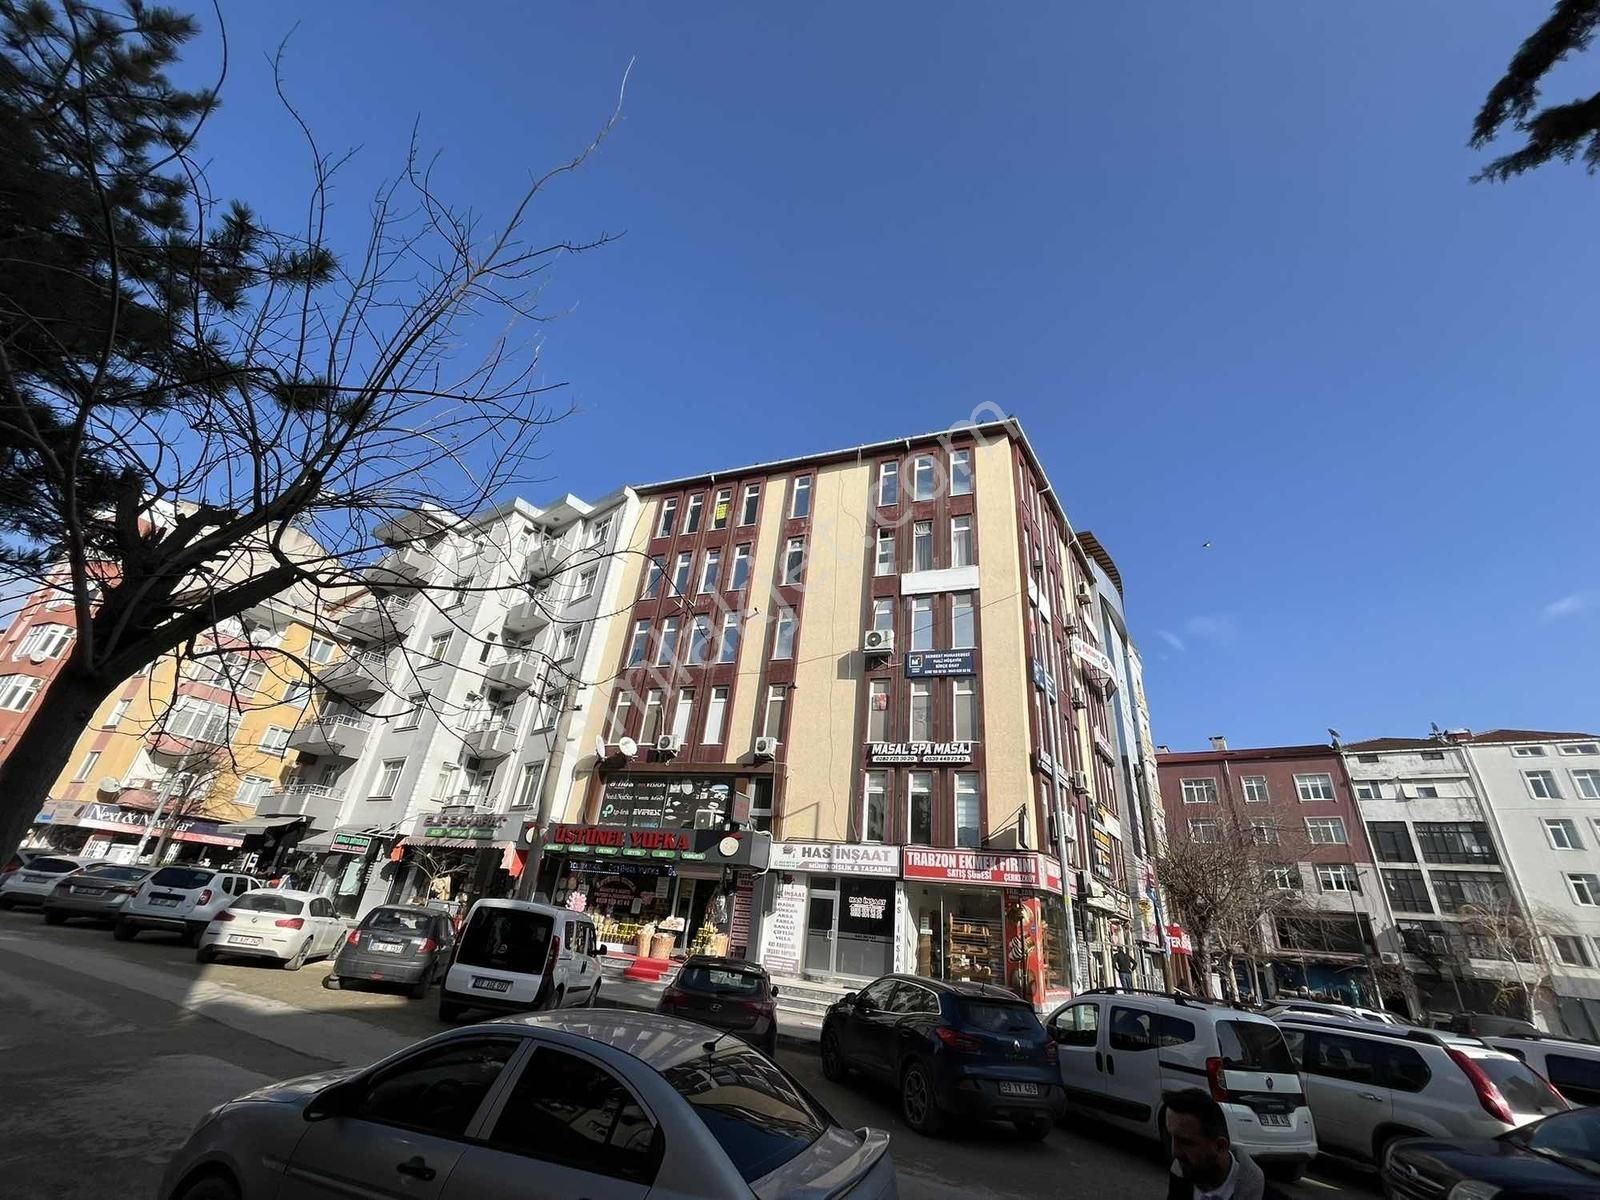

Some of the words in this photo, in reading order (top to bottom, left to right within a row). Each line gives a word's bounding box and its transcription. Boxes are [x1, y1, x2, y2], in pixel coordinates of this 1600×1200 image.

[872, 743, 909, 755] MASAL
[910, 744, 932, 755] SPA
[933, 742, 972, 755] MASAJ
[89, 804, 123, 822] Next
[121, 811, 138, 824] &
[629, 829, 690, 851] YUFKA
[801, 846, 832, 860] HAS
[835, 845, 892, 863] İNŞAAT
[907, 851, 957, 868] TRABZON
[958, 854, 998, 871] EKMEK
[999, 856, 1036, 874] FIRINI
[946, 868, 967, 881] SATIŞ
[967, 869, 992, 882] ŞUBESİ
[894, 887, 904, 914] HAS
